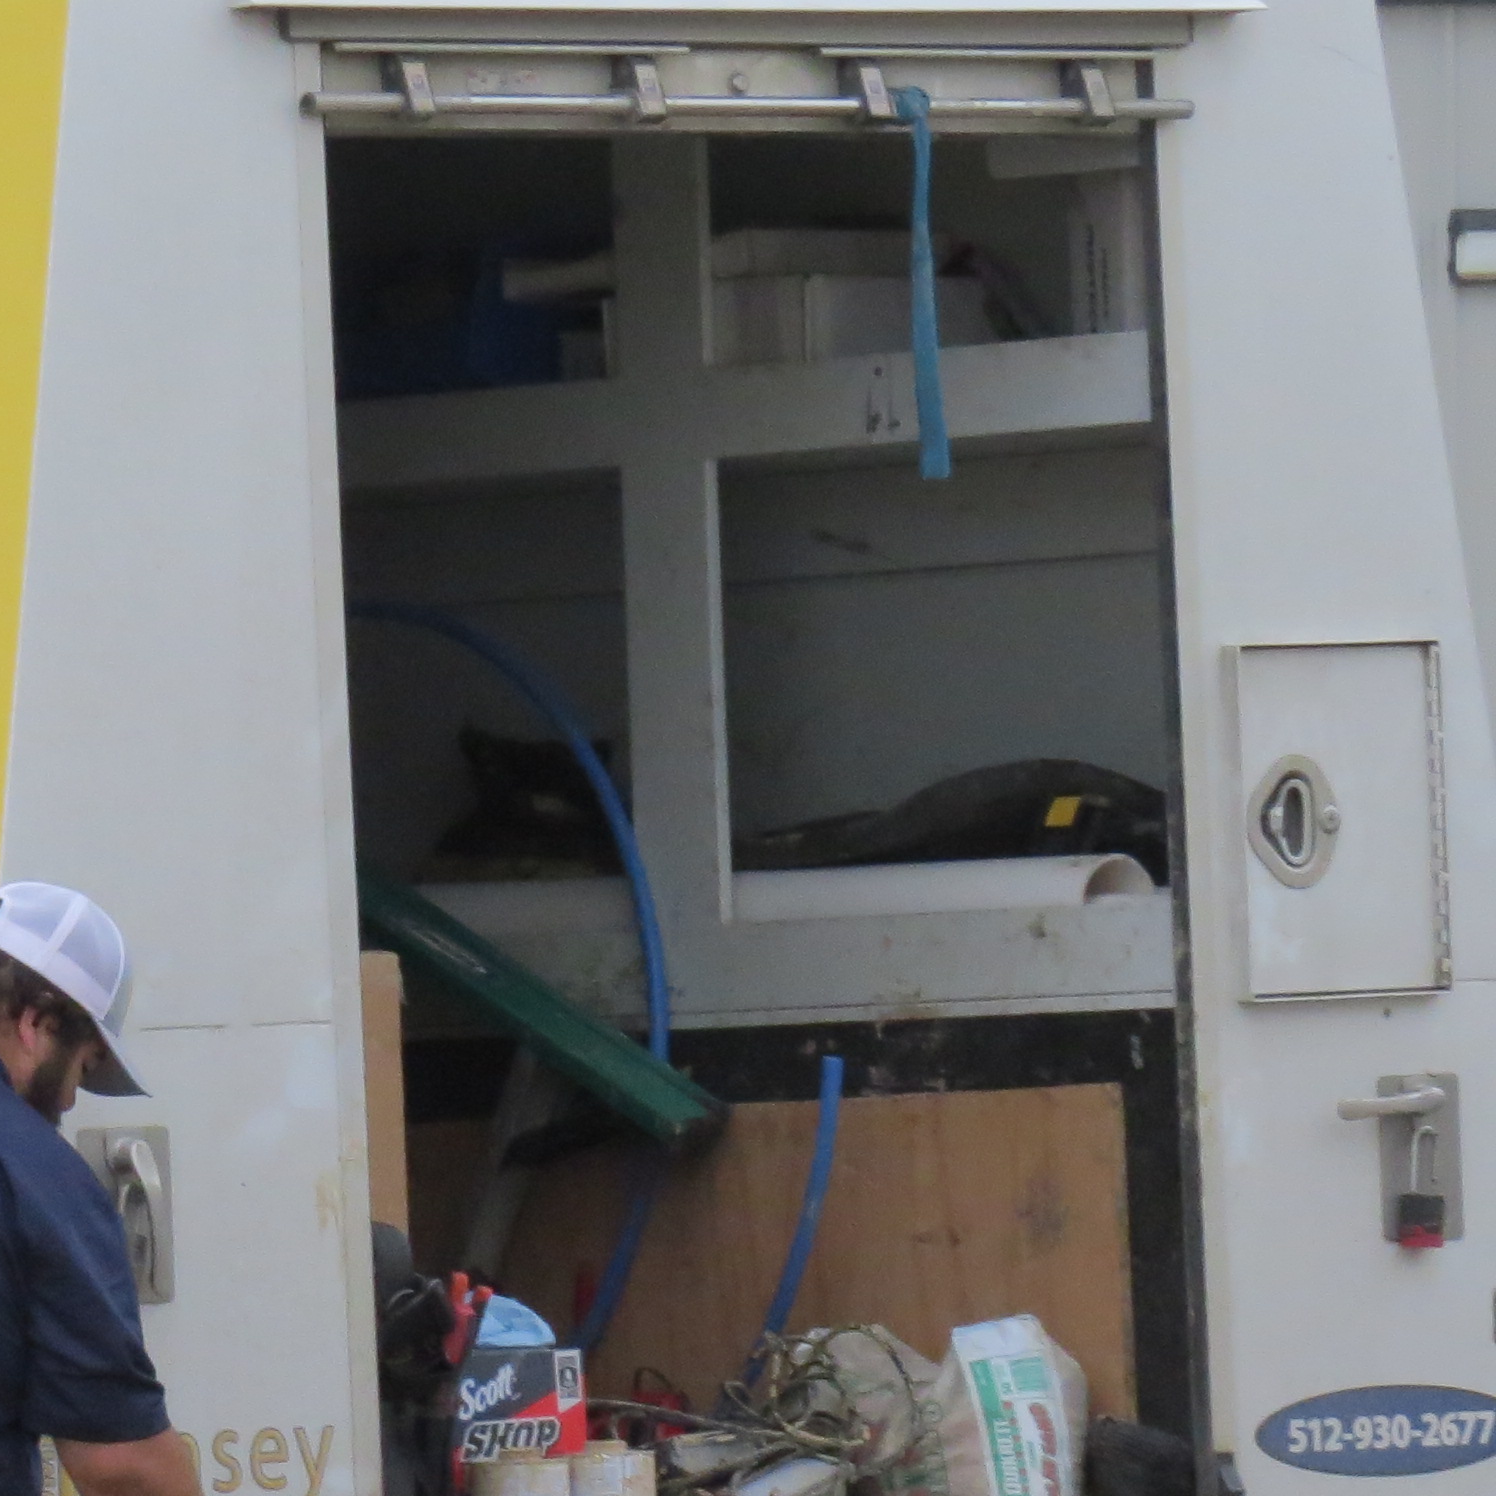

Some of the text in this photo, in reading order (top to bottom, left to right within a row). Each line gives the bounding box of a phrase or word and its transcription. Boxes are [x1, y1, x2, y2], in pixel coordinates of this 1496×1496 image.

[458, 1362, 515, 1420] Scott
[461, 1416, 561, 1464] SHOP
[1288, 1410, 1496, 1453] 512-930-2677
